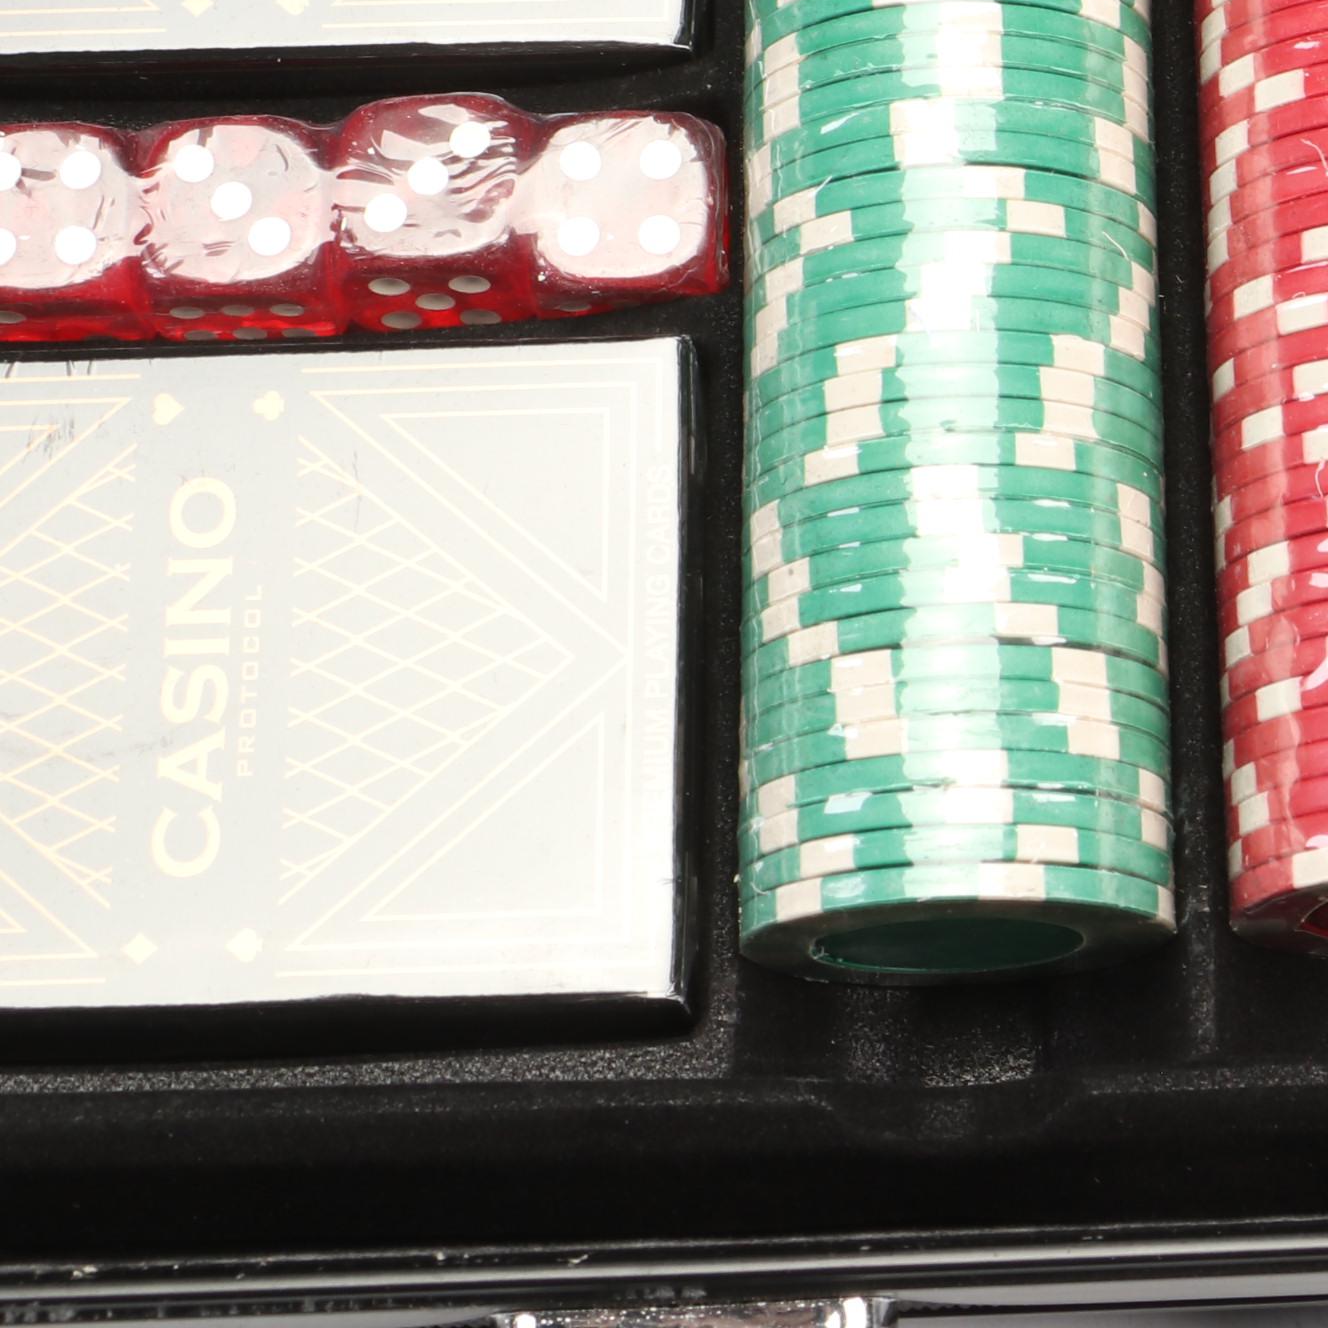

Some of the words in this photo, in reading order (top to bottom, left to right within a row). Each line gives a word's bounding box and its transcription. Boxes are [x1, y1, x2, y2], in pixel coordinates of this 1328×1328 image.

[647, 465, 671, 566] CARDS
[152, 478, 236, 877] CASINO
[238, 584, 261, 776] PROTOCOL
[643, 574, 671, 698] PLAYING
